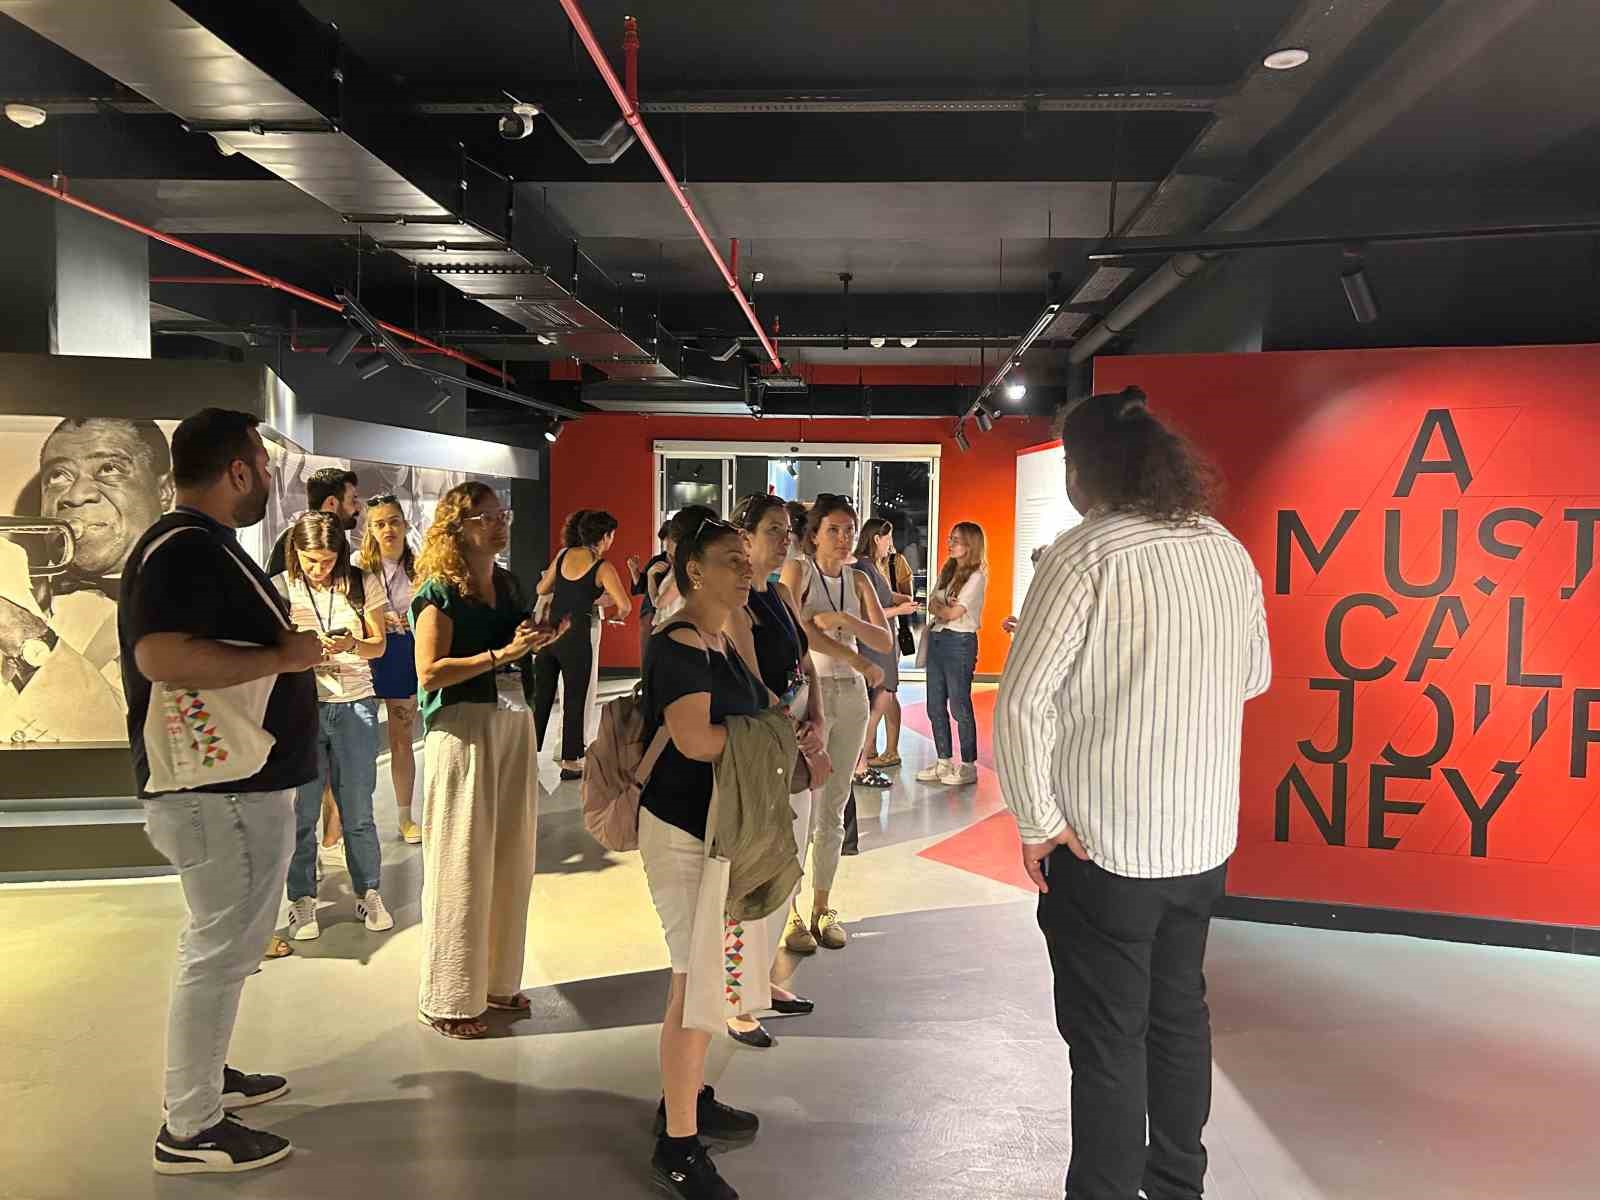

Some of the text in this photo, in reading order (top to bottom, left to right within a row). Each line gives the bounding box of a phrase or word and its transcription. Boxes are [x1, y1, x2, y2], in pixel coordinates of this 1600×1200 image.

[1393, 409, 1472, 497] A
[1325, 593, 1563, 688] CAL
[1275, 762, 1522, 858] NEY
